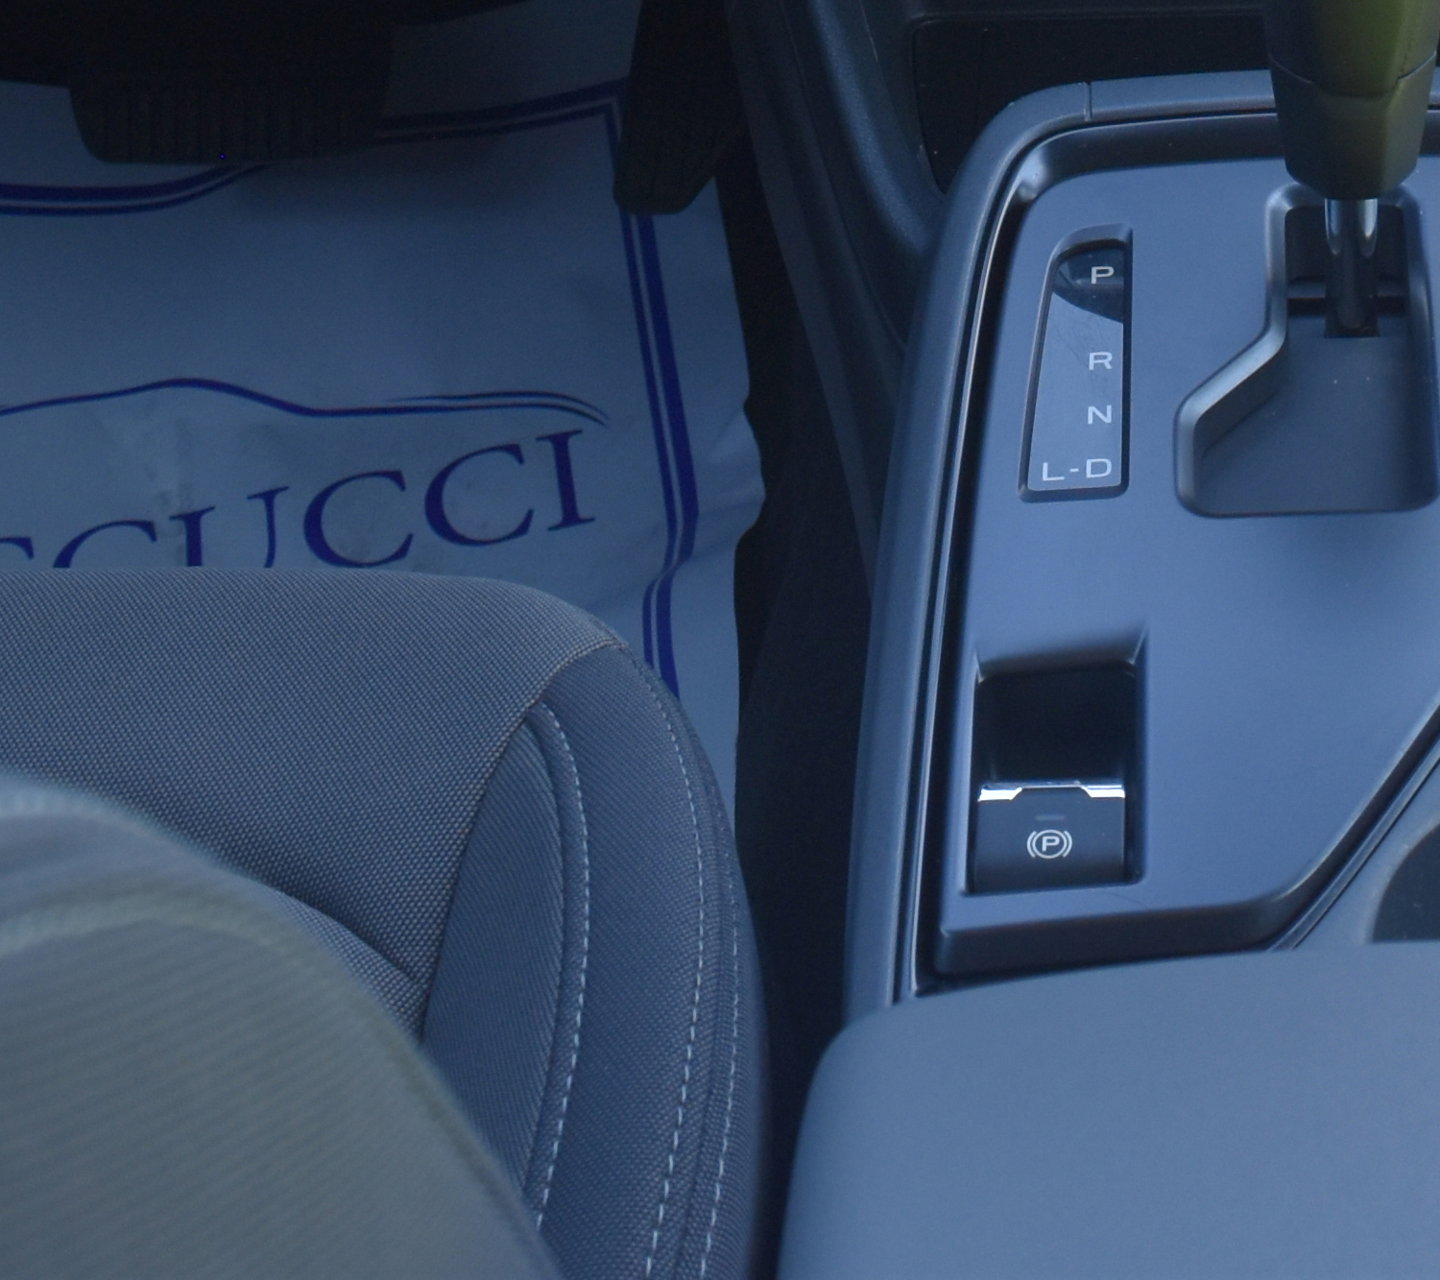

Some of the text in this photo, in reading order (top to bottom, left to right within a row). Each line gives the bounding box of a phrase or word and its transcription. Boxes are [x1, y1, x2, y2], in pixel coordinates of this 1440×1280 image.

[1090, 266, 1115, 284] P
[1088, 351, 1113, 370] R
[1087, 405, 1112, 424] N
